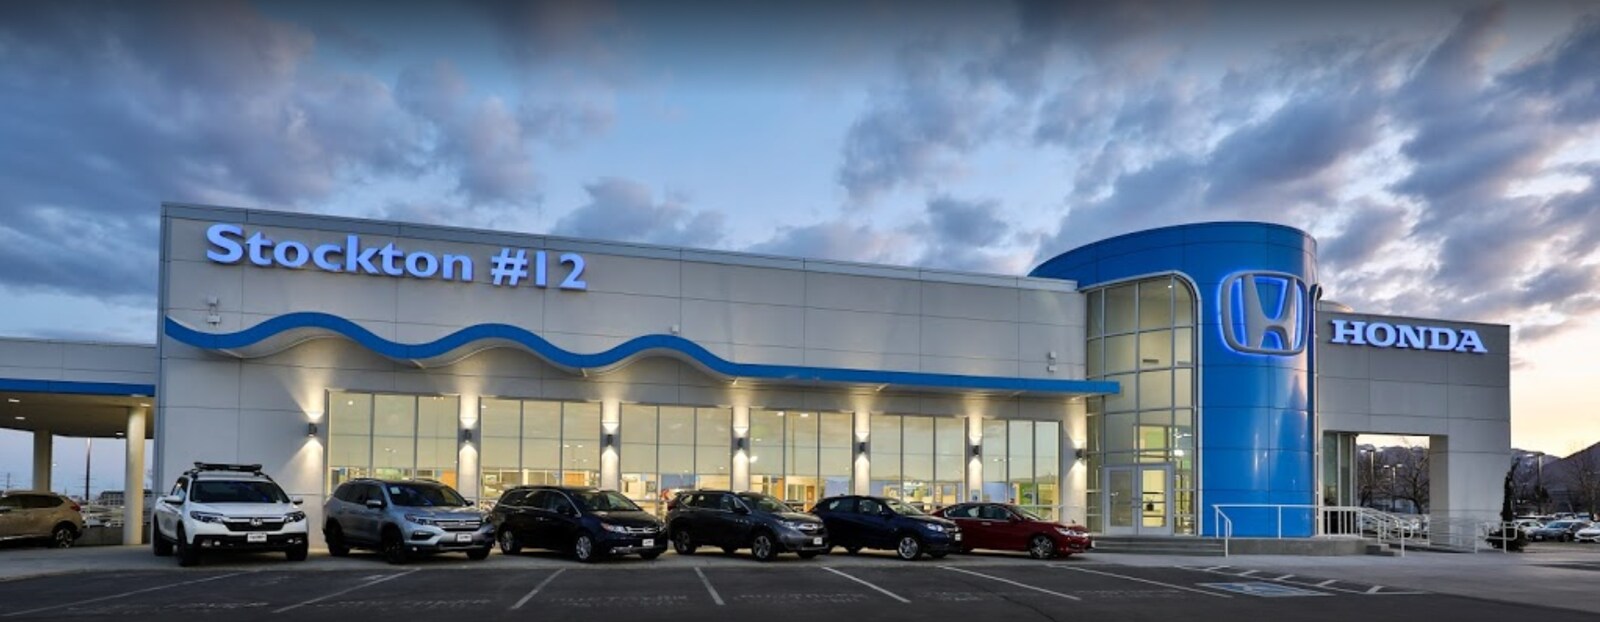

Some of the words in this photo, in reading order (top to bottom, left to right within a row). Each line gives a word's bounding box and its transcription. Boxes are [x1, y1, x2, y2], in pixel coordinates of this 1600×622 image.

[206, 223, 474, 282] Stockton
[491, 247, 588, 291] #12
[1331, 319, 1488, 354] HONDA
